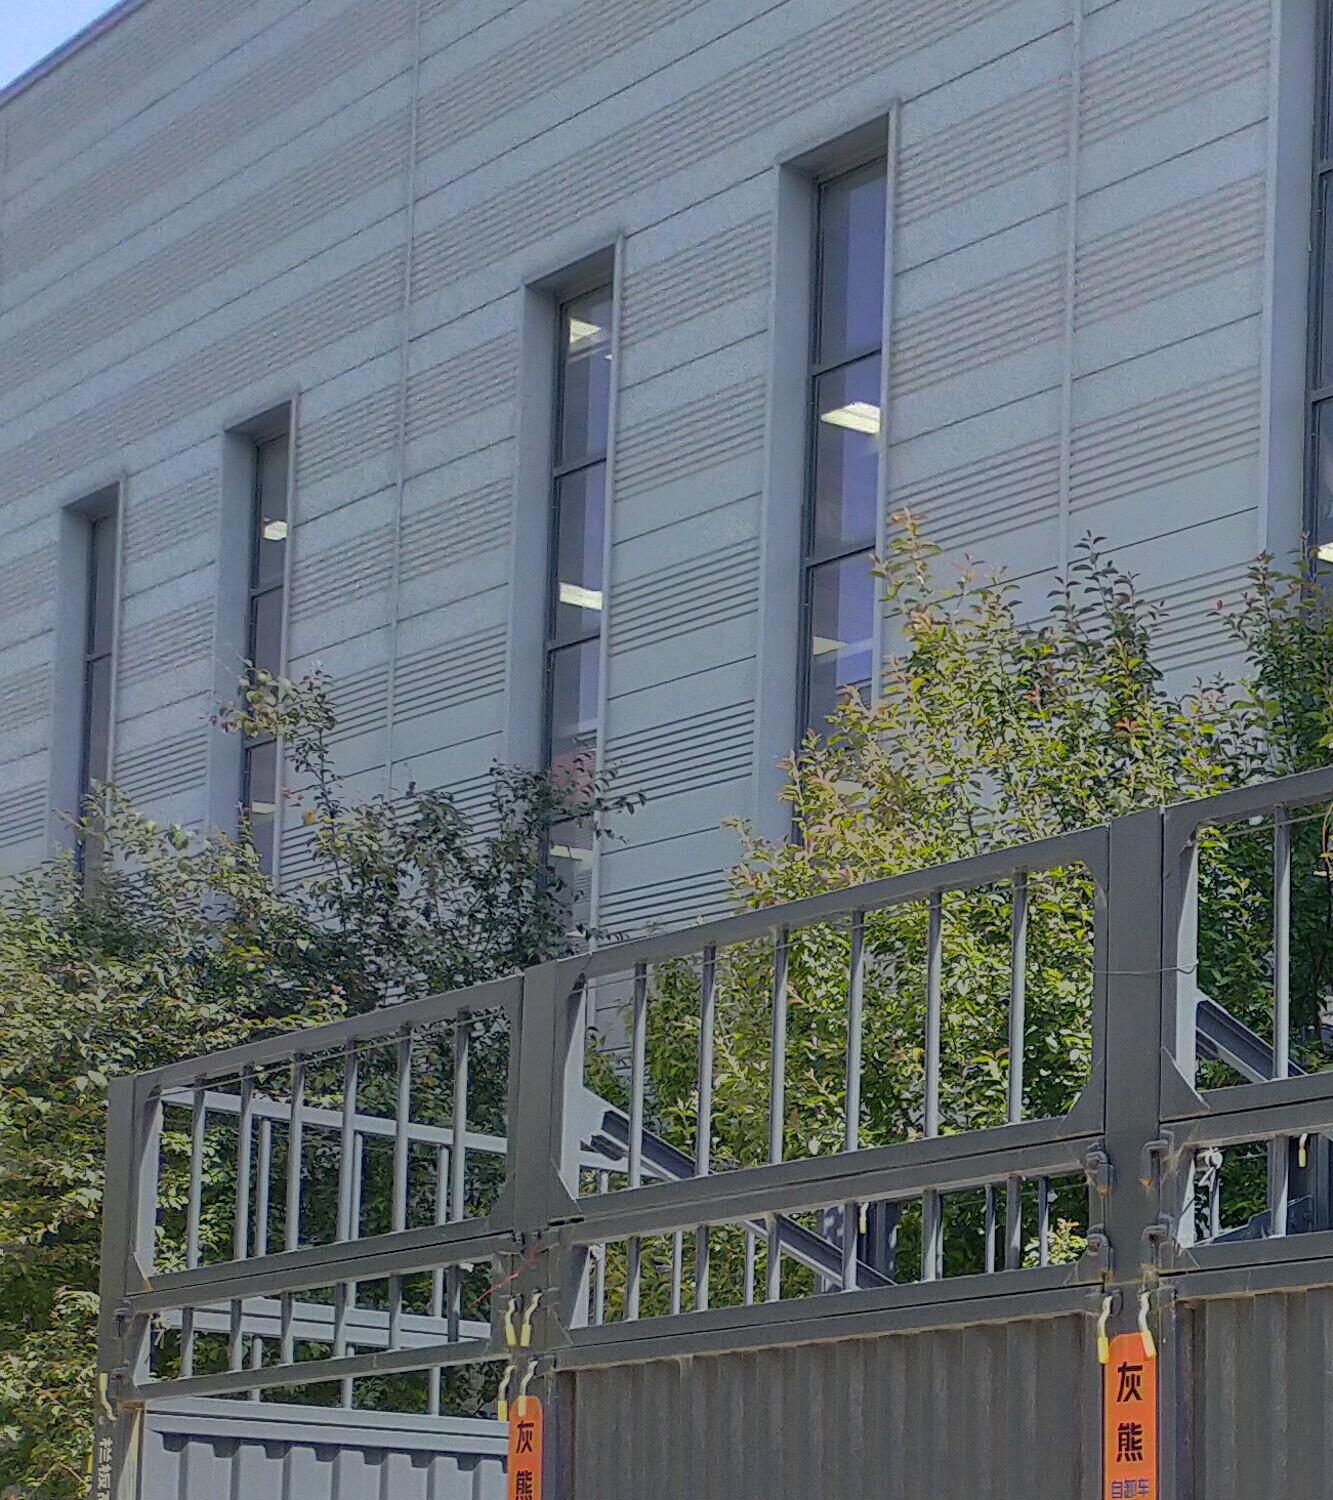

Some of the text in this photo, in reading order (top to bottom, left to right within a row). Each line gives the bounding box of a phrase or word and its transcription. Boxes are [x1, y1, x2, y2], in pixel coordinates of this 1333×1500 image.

[1116, 1361, 1143, 1463] 灰熊
[1110, 1478, 1150, 1500] 自卸车
